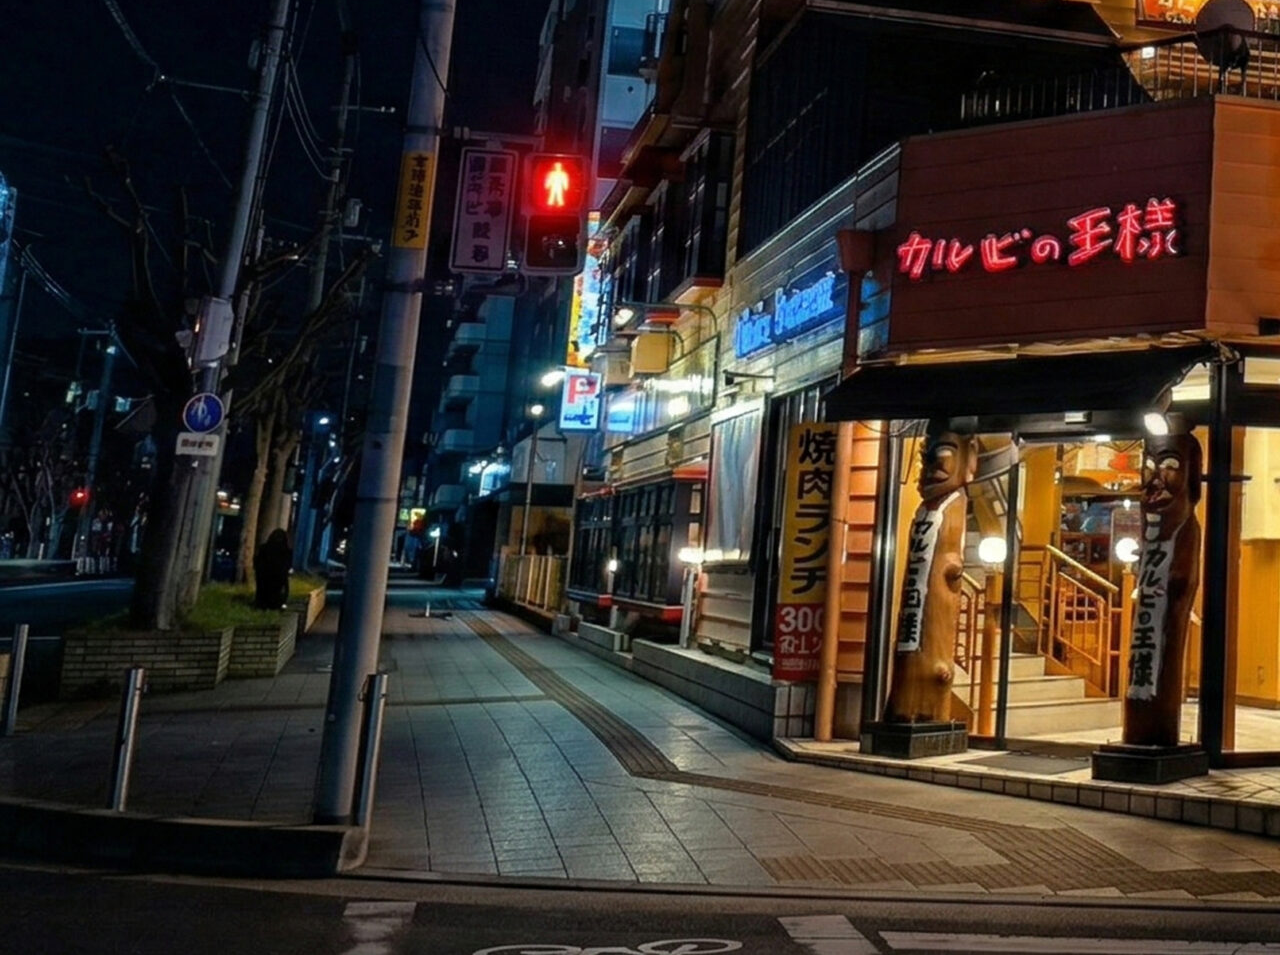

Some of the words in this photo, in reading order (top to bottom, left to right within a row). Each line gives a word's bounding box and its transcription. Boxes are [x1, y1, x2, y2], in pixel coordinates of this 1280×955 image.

[897, 197, 1178, 281] カルビの王様
[791, 429, 838, 594] 焼肉ランチ
